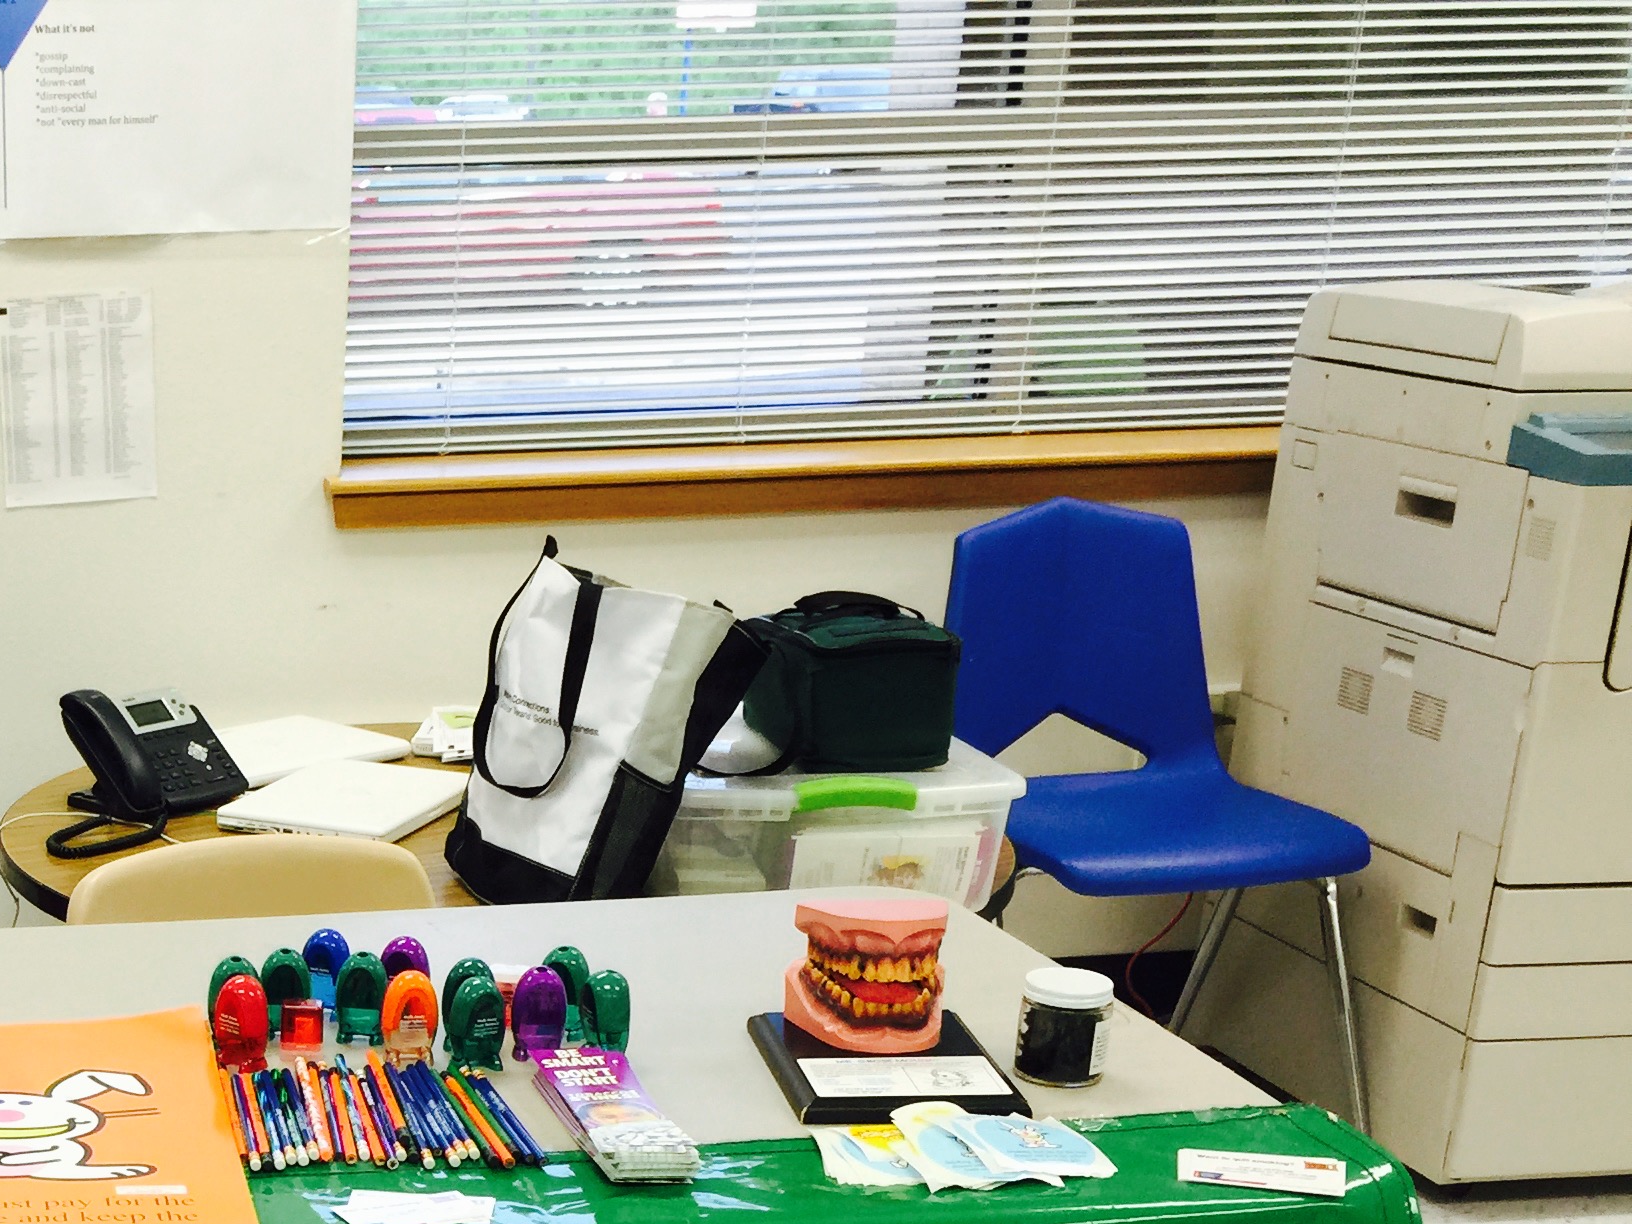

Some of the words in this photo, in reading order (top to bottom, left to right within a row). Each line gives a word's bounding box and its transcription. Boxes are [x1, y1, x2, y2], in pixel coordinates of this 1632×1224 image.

[35, 24, 60, 34] What
[63, 24, 77, 34] it's
[79, 24, 95, 34] not
[553, 1049, 582, 1059] BE
[540, 1055, 606, 1069] SMART
[553, 1067, 612, 1080] DON'T
[560, 1075, 618, 1087] START
[44, 1198, 92, 1211] pay
[105, 1195, 144, 1207] for
[154, 1194, 196, 1207] the
[18, 1211, 69, 1224] and
[79, 1210, 146, 1224] keep
[155, 1209, 199, 1222] the
